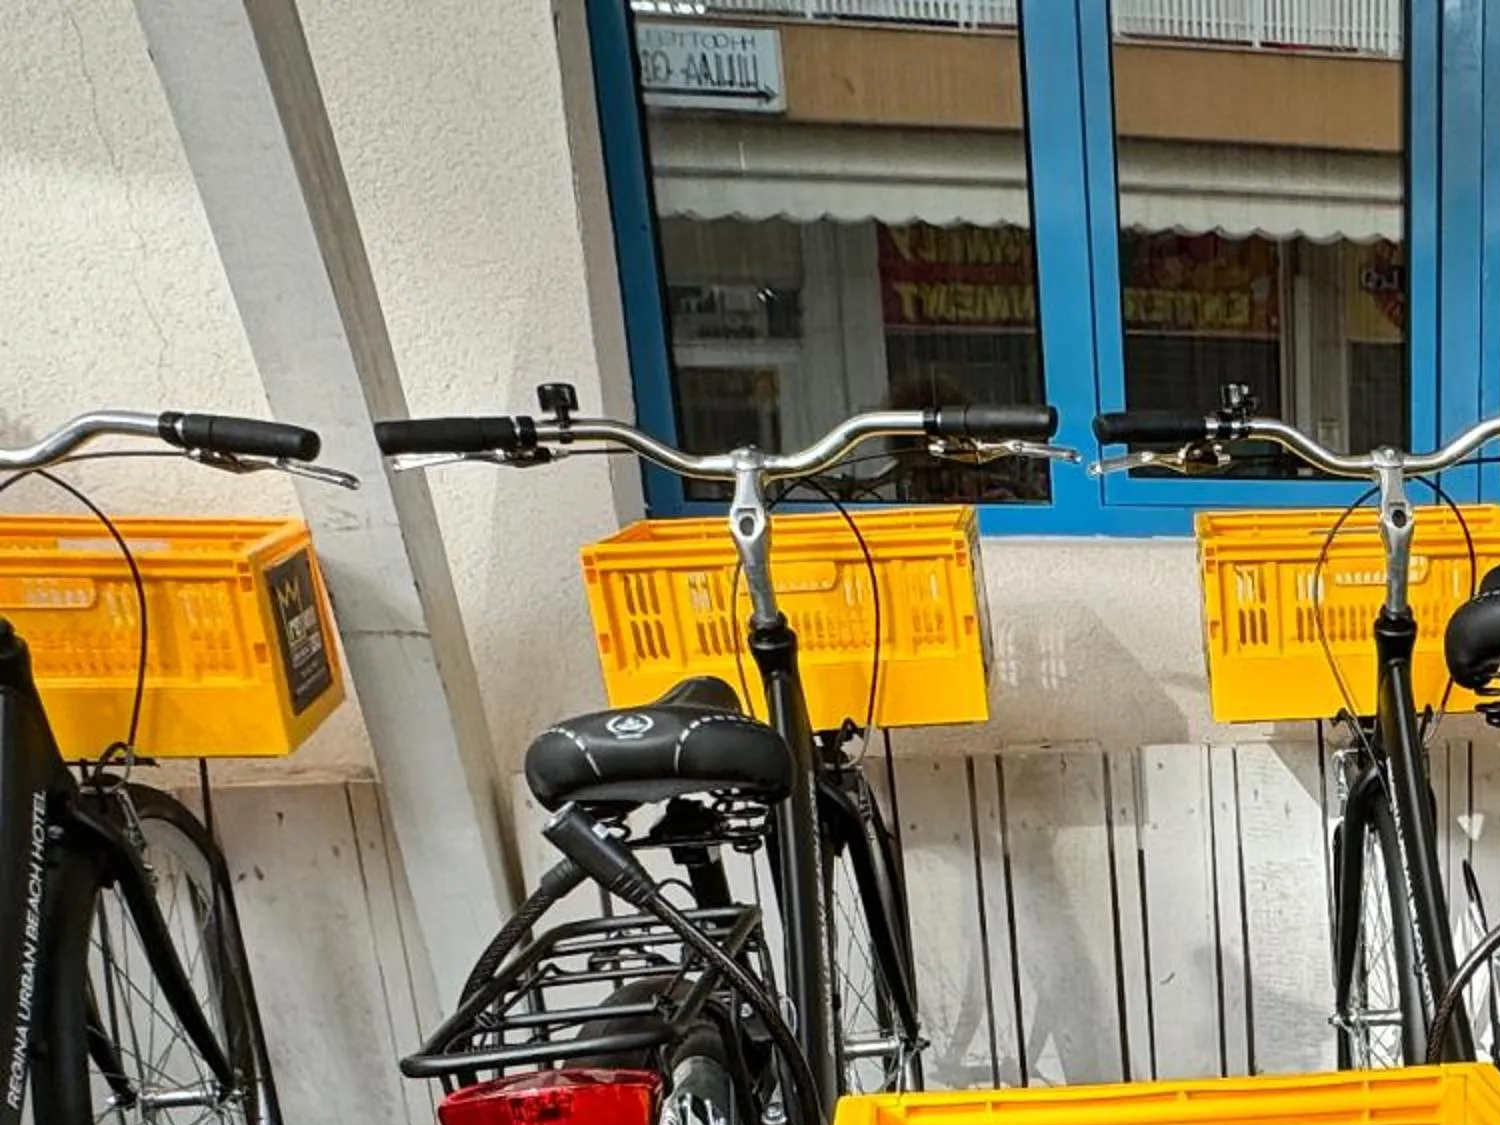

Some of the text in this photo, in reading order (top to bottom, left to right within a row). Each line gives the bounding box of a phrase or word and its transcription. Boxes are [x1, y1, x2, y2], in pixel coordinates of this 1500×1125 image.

[7, 789, 47, 1111] REGINA URBAN BEACH HOTEL
